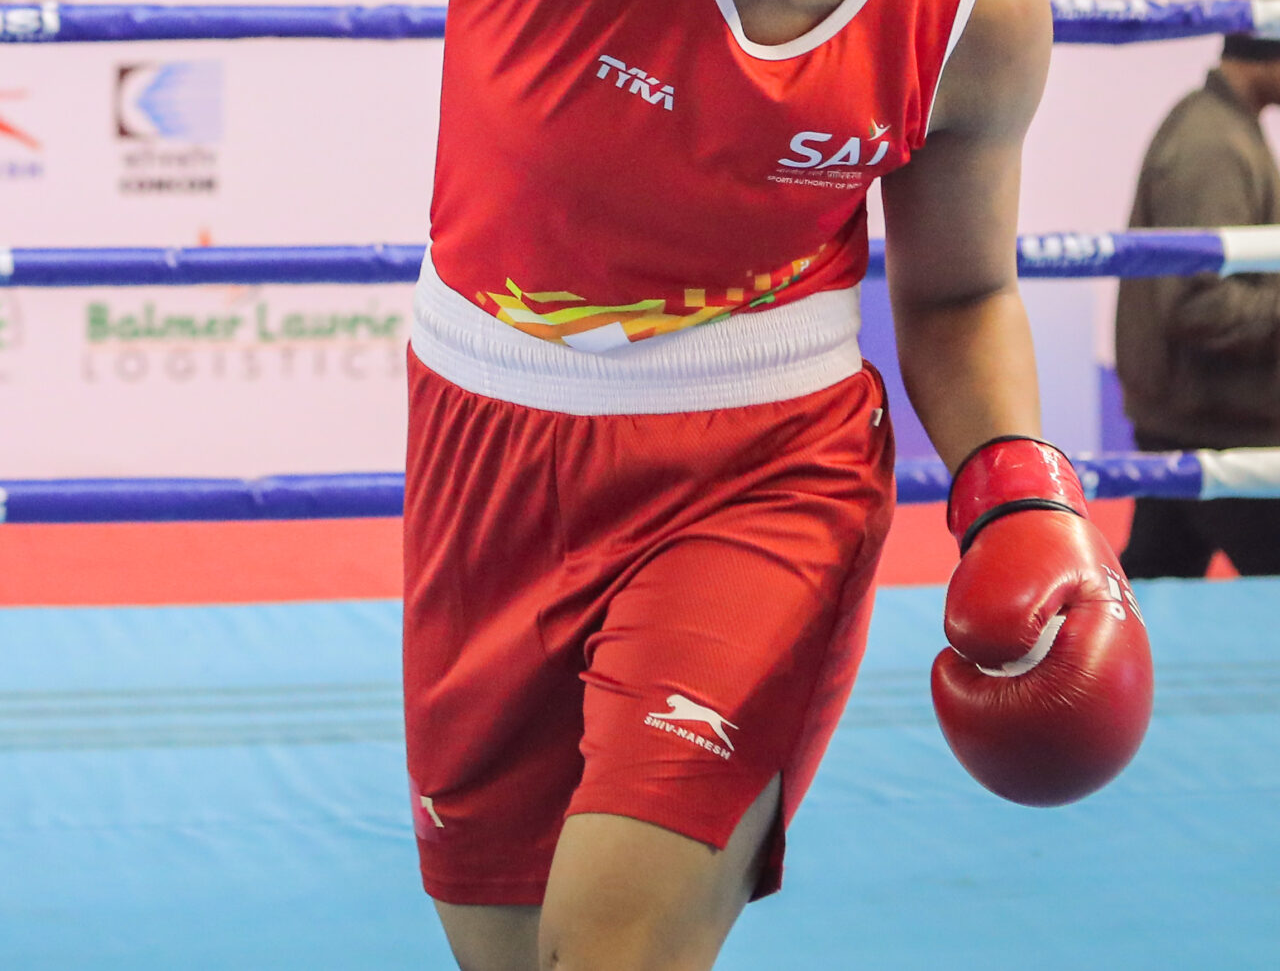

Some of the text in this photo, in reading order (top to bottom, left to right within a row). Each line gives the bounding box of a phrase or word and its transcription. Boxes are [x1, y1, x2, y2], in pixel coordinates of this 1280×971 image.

[597, 55, 674, 111] TYKA
[794, 178, 833, 188] AUTHORITY
[87, 304, 404, 342] Balmer Lawrie
[82, 346, 405, 384] LOGISTICS
[643, 715, 732, 761] SHIV-NARESH
